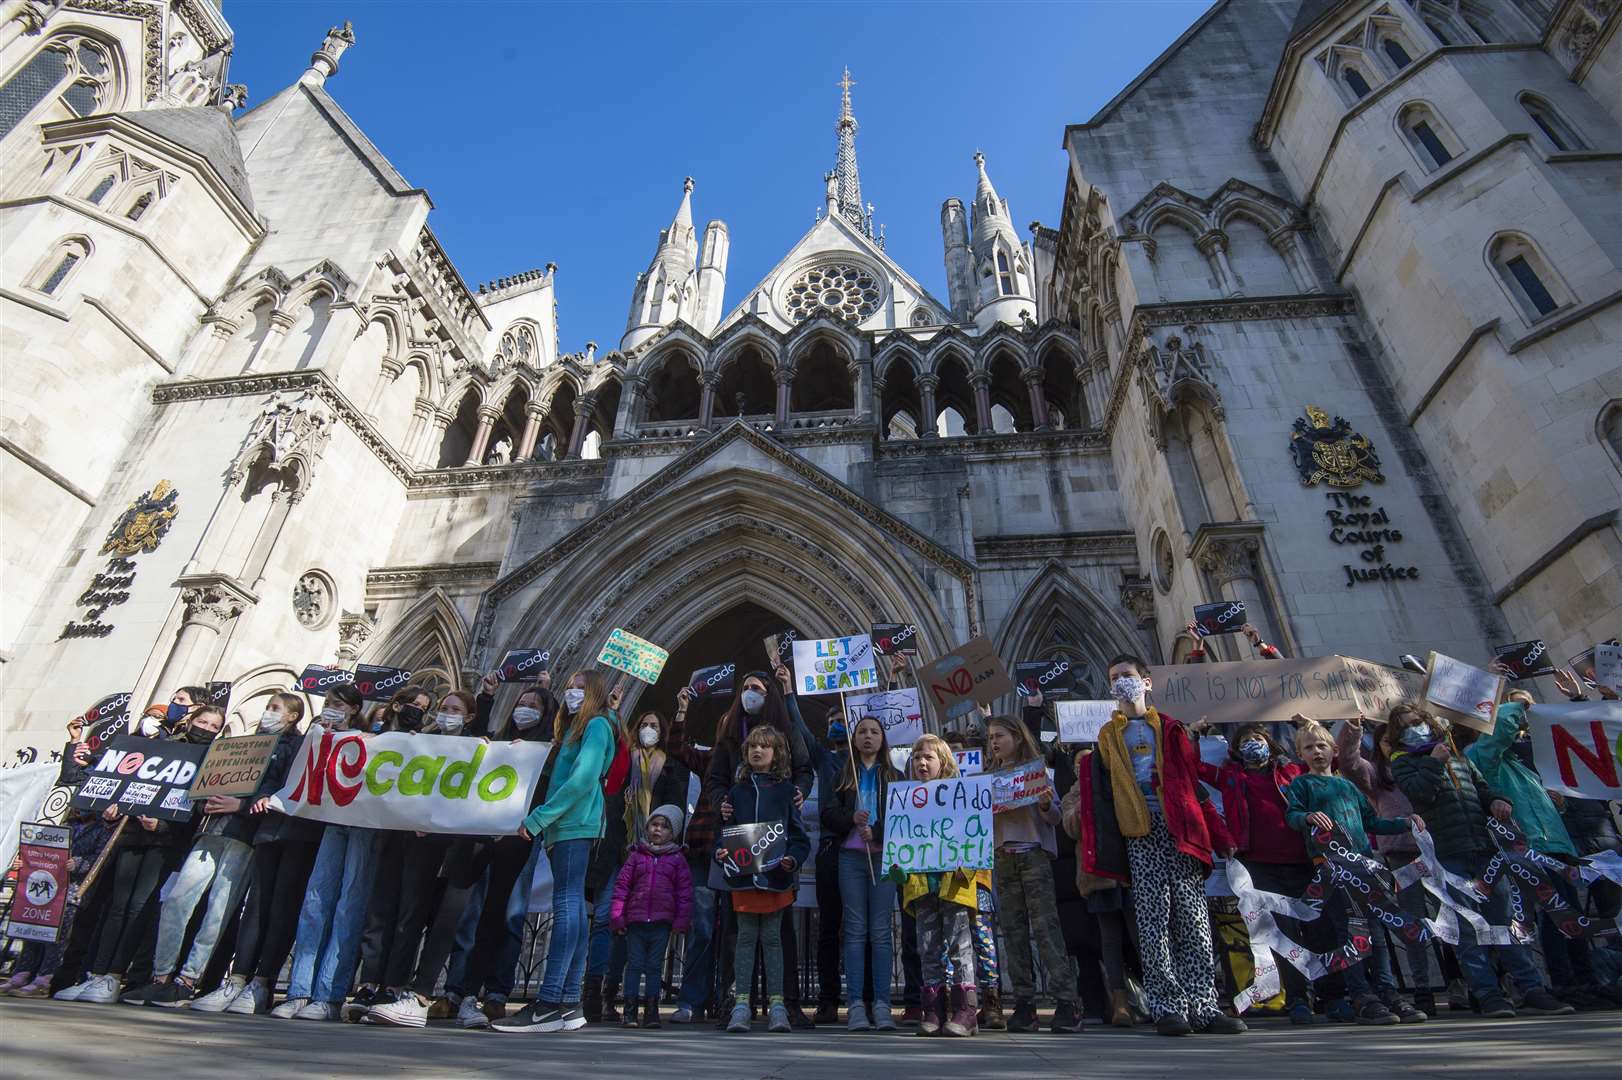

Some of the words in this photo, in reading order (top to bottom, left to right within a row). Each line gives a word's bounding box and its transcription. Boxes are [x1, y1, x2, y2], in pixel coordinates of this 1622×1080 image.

[1326, 492, 1372, 510] The
[1326, 508, 1391, 529] Royal
[1329, 528, 1404, 545] Courts
[1361, 545, 1385, 564] of
[91, 572, 137, 590] Royal
[1344, 563, 1420, 587] Justice
[55, 620, 115, 642] Justice
[815, 637, 852, 658] LET
[601, 652, 659, 682] FUTURE
[804, 667, 878, 693] BREATHE
[932, 667, 975, 705] NO
[1165, 673, 1197, 702] AIR
[1236, 674, 1268, 700] NOT
[1280, 672, 1310, 700] FOR
[964, 814, 989, 838] a
[22, 906, 52, 921] ZONE
